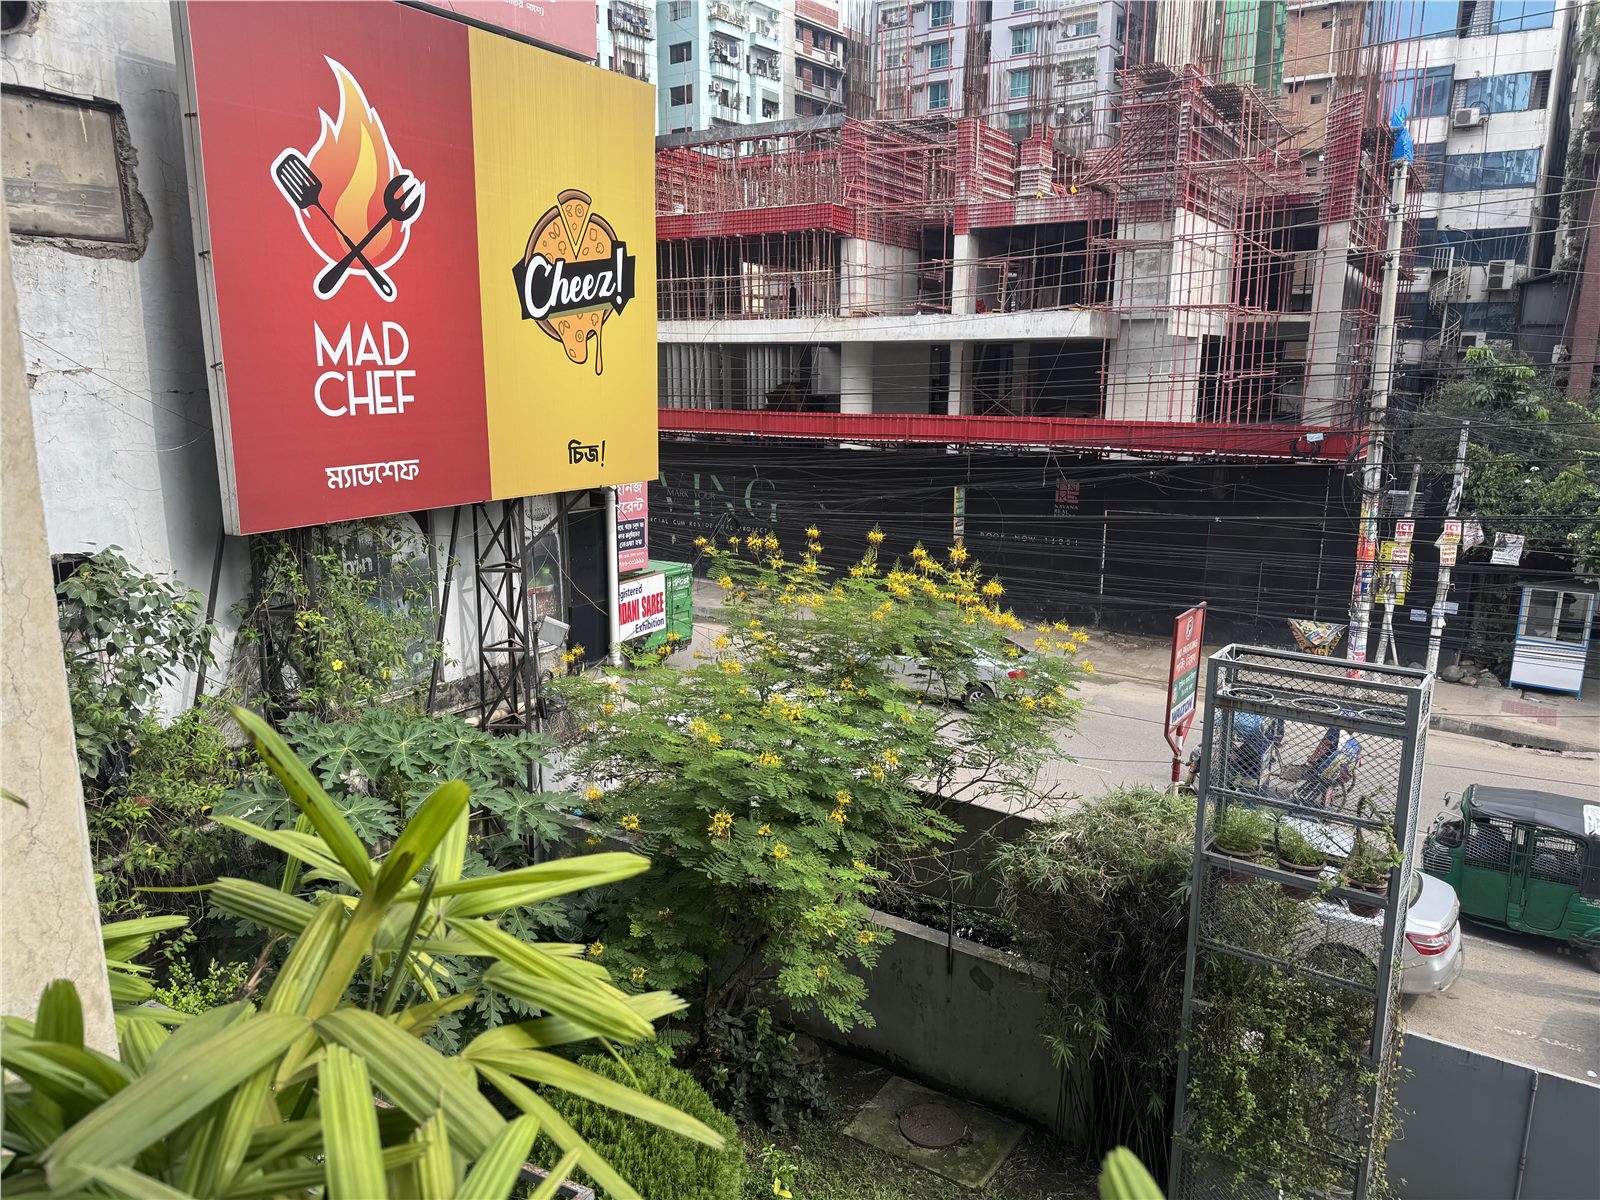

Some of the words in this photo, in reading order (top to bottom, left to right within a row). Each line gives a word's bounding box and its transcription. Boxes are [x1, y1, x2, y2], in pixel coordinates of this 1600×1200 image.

[524, 247, 624, 318] Cheez!
[313, 320, 410, 367] MAD
[313, 370, 417, 417] CHEF
[568, 439, 606, 468] চিজ!
[325, 459, 420, 490] ম্যাডশেফ
[1396, 523, 1414, 531] ICT
[1445, 523, 1460, 531] ICT
[641, 592, 664, 618] SAREE
[635, 617, 665, 633] Exhibition
